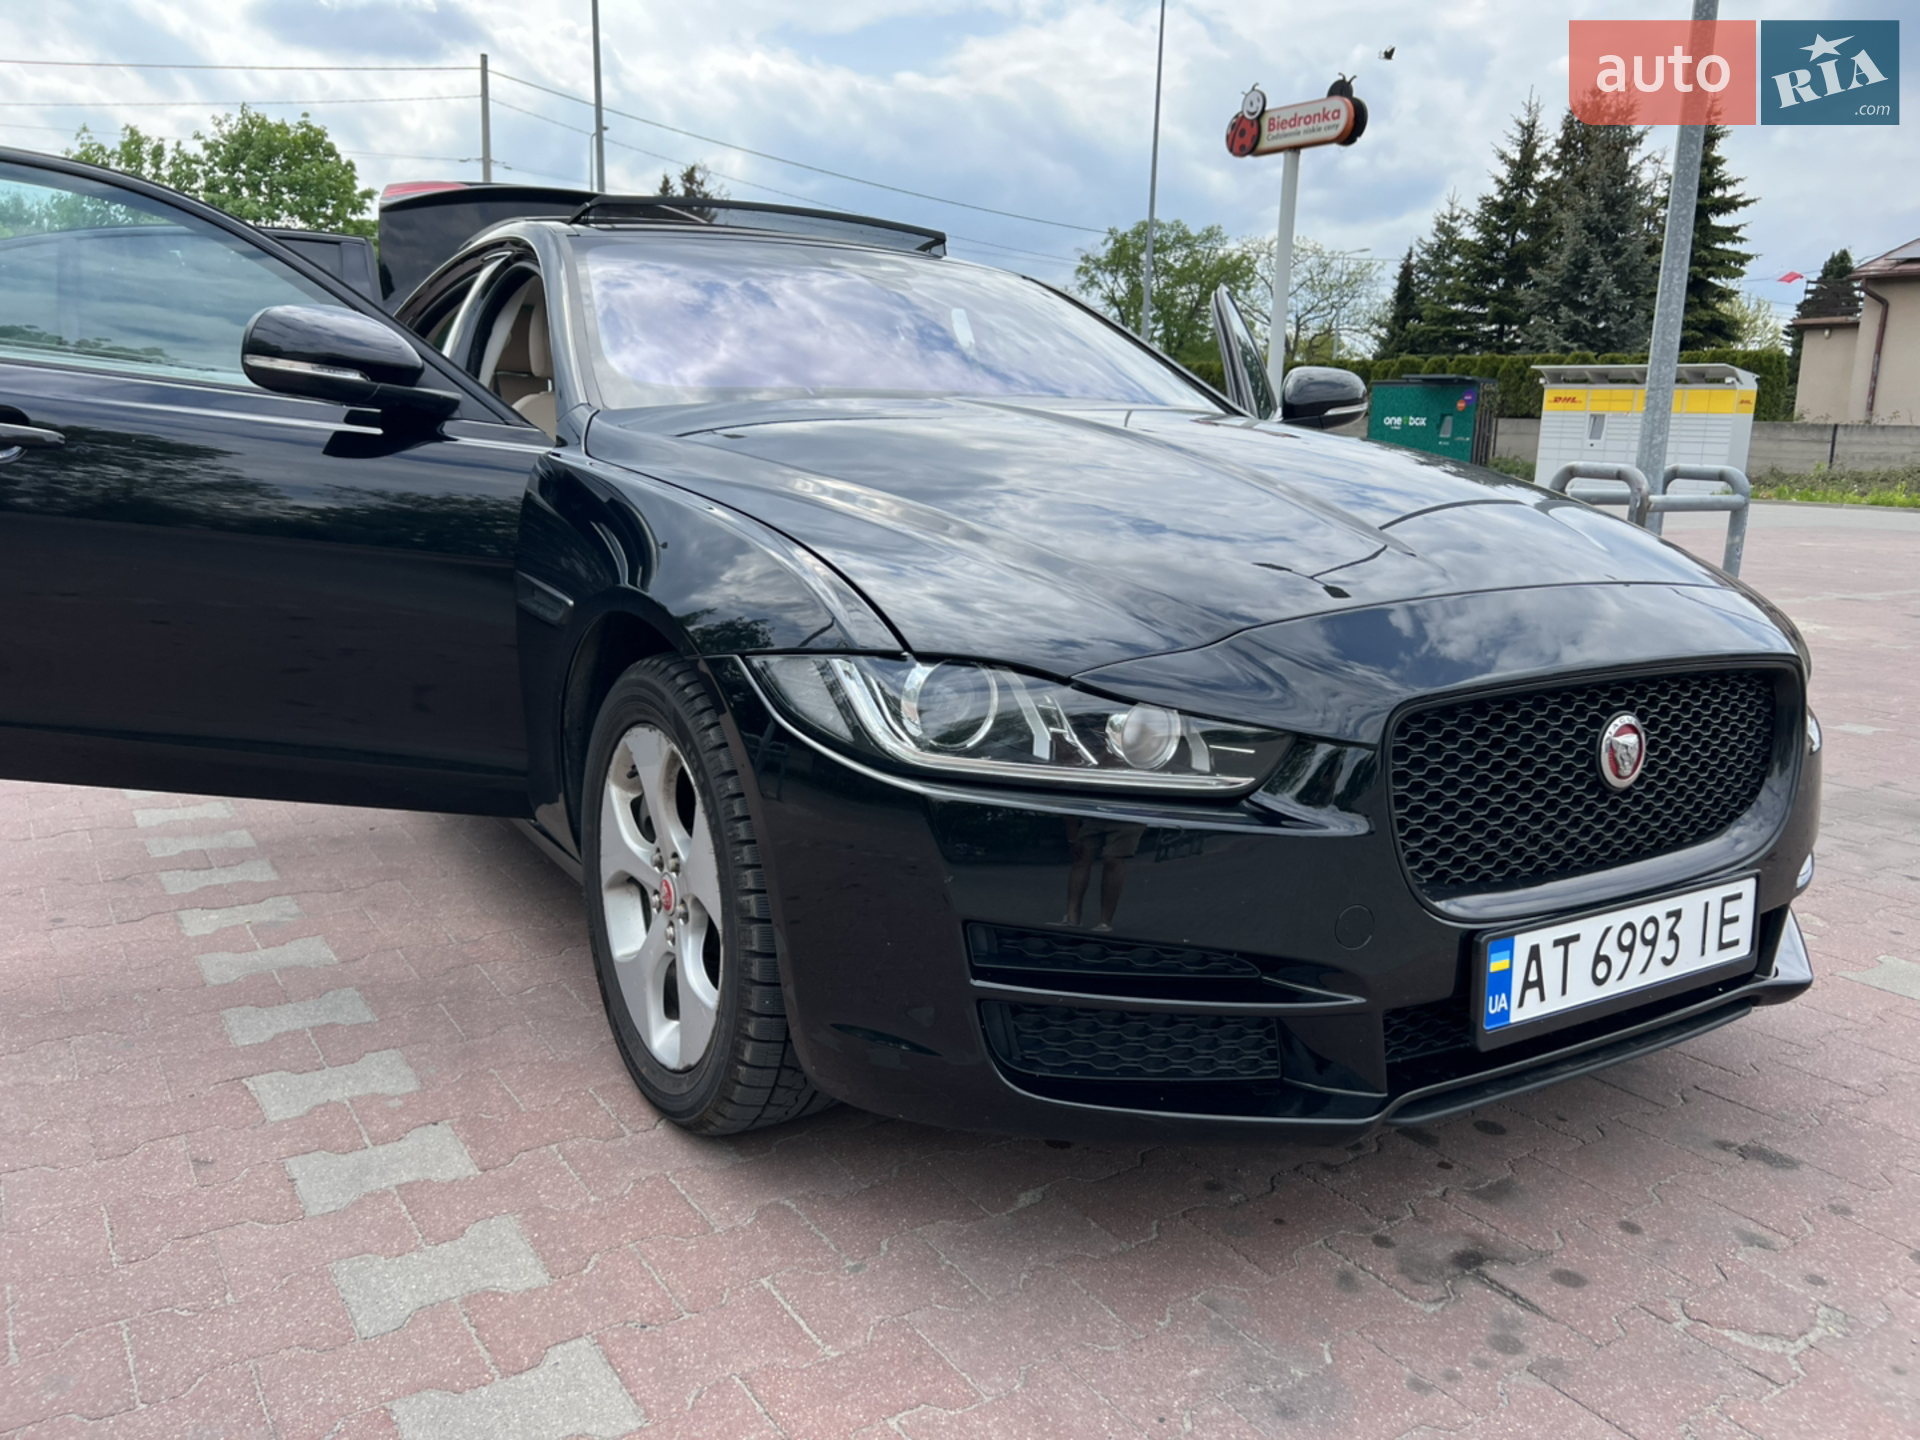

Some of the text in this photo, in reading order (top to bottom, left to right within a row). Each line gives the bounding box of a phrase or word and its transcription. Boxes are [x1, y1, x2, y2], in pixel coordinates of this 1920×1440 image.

[1267, 107, 1341, 132] Biedronka
[1266, 123, 1340, 141] Codziennie niskie ceny
[1553, 396, 1577, 404] DHL
[1517, 892, 1743, 1009] AT 6993 IE
[1488, 993, 1508, 1014] UA
